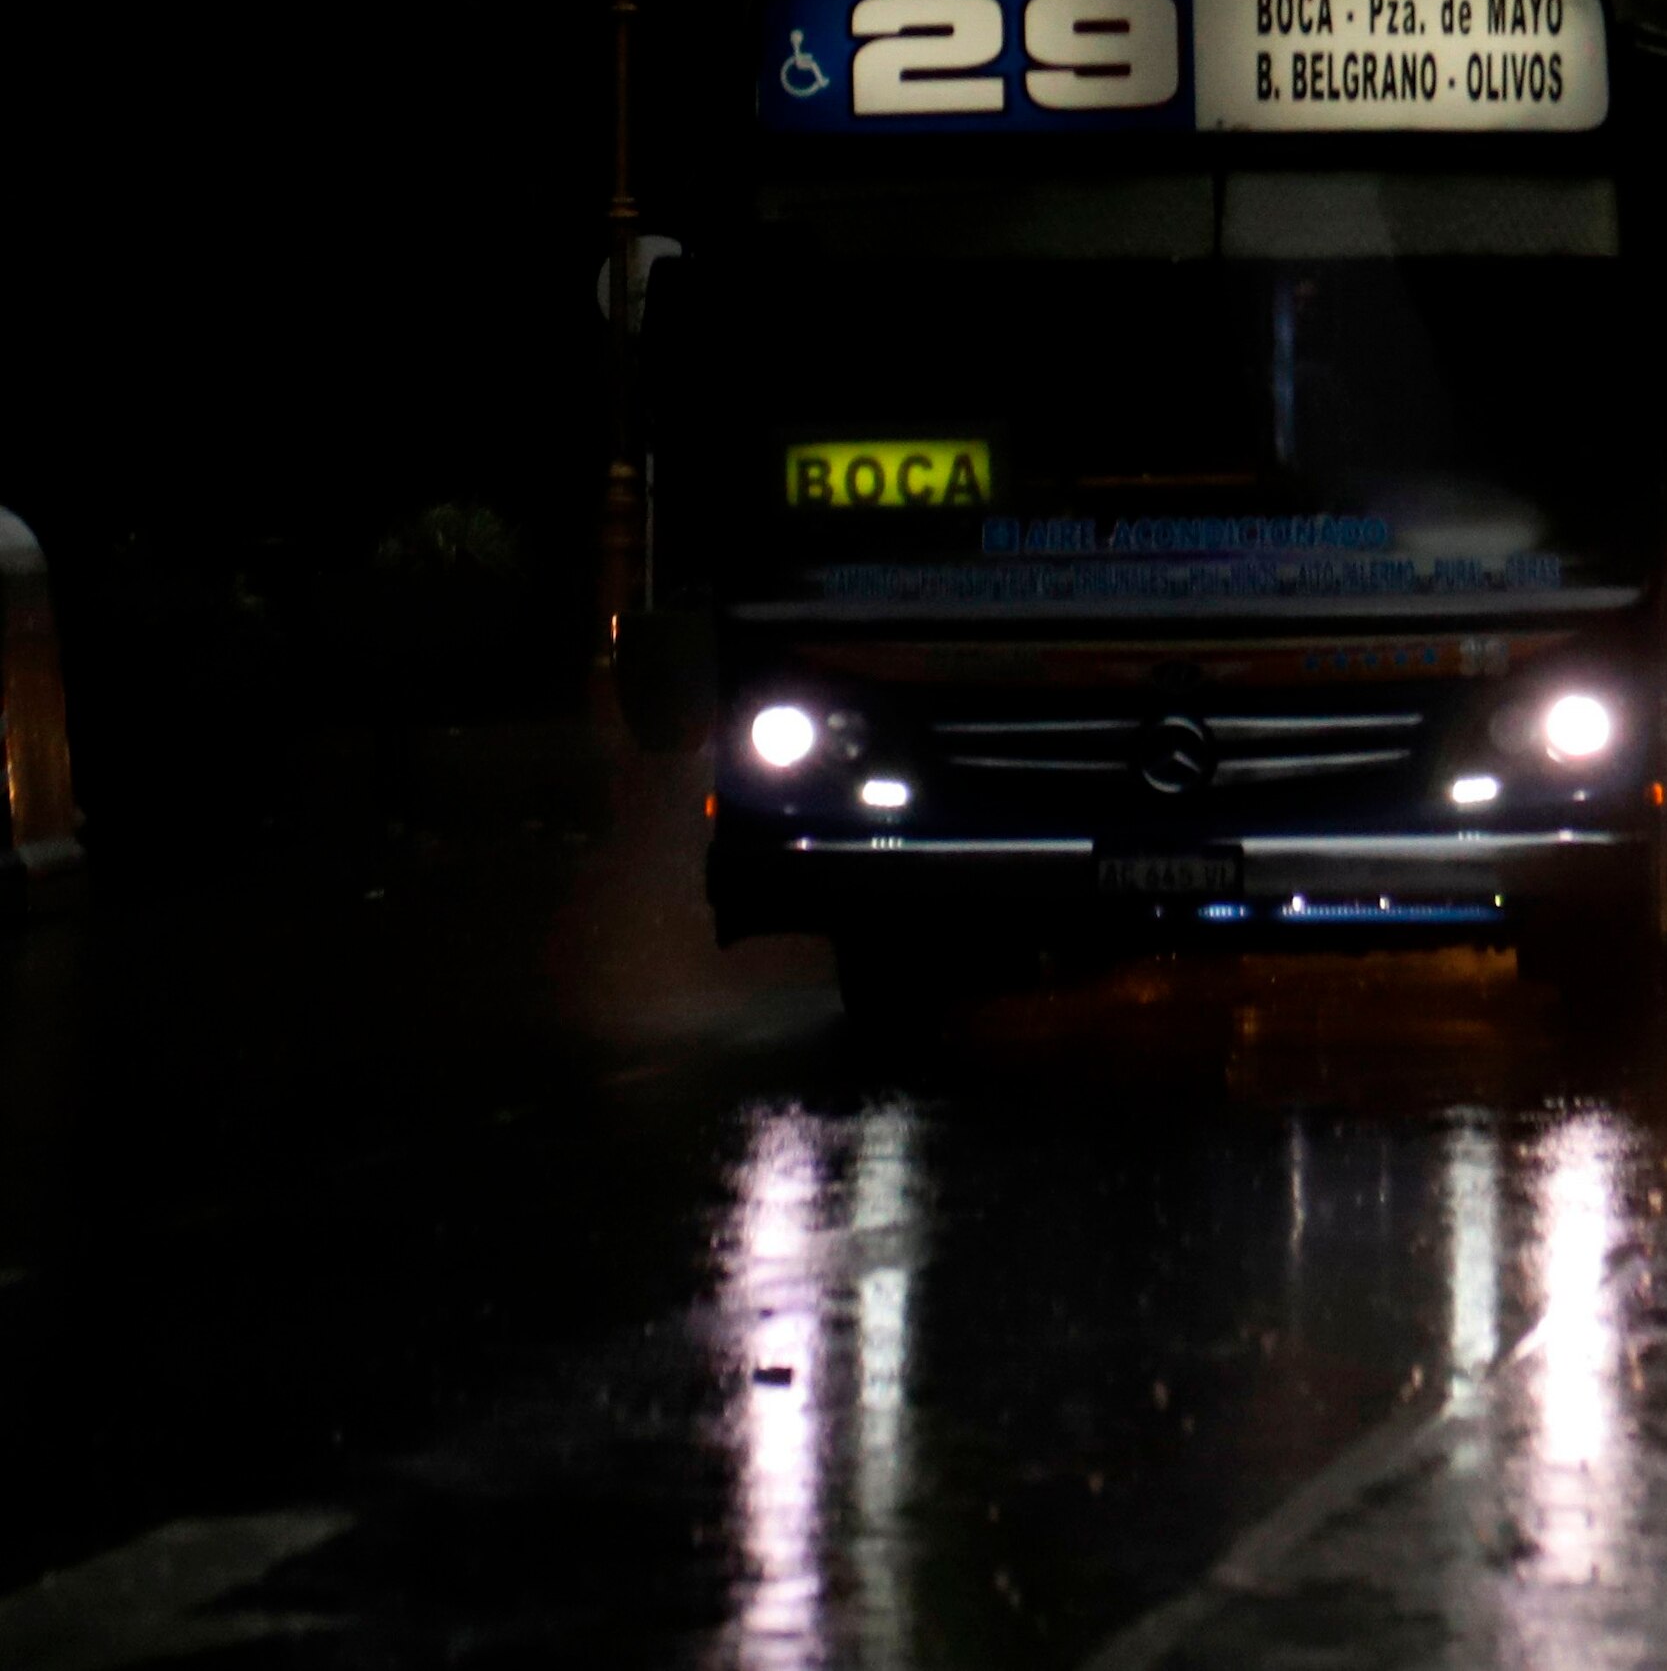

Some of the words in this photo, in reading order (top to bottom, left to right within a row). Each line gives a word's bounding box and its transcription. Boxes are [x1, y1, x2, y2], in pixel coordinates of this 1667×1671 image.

[1256, 51, 1281, 102] B.
[1292, 51, 1437, 102] BELGRANO
[1467, 51, 1563, 102] OLIVOS
[797, 453, 983, 507] BOCA
